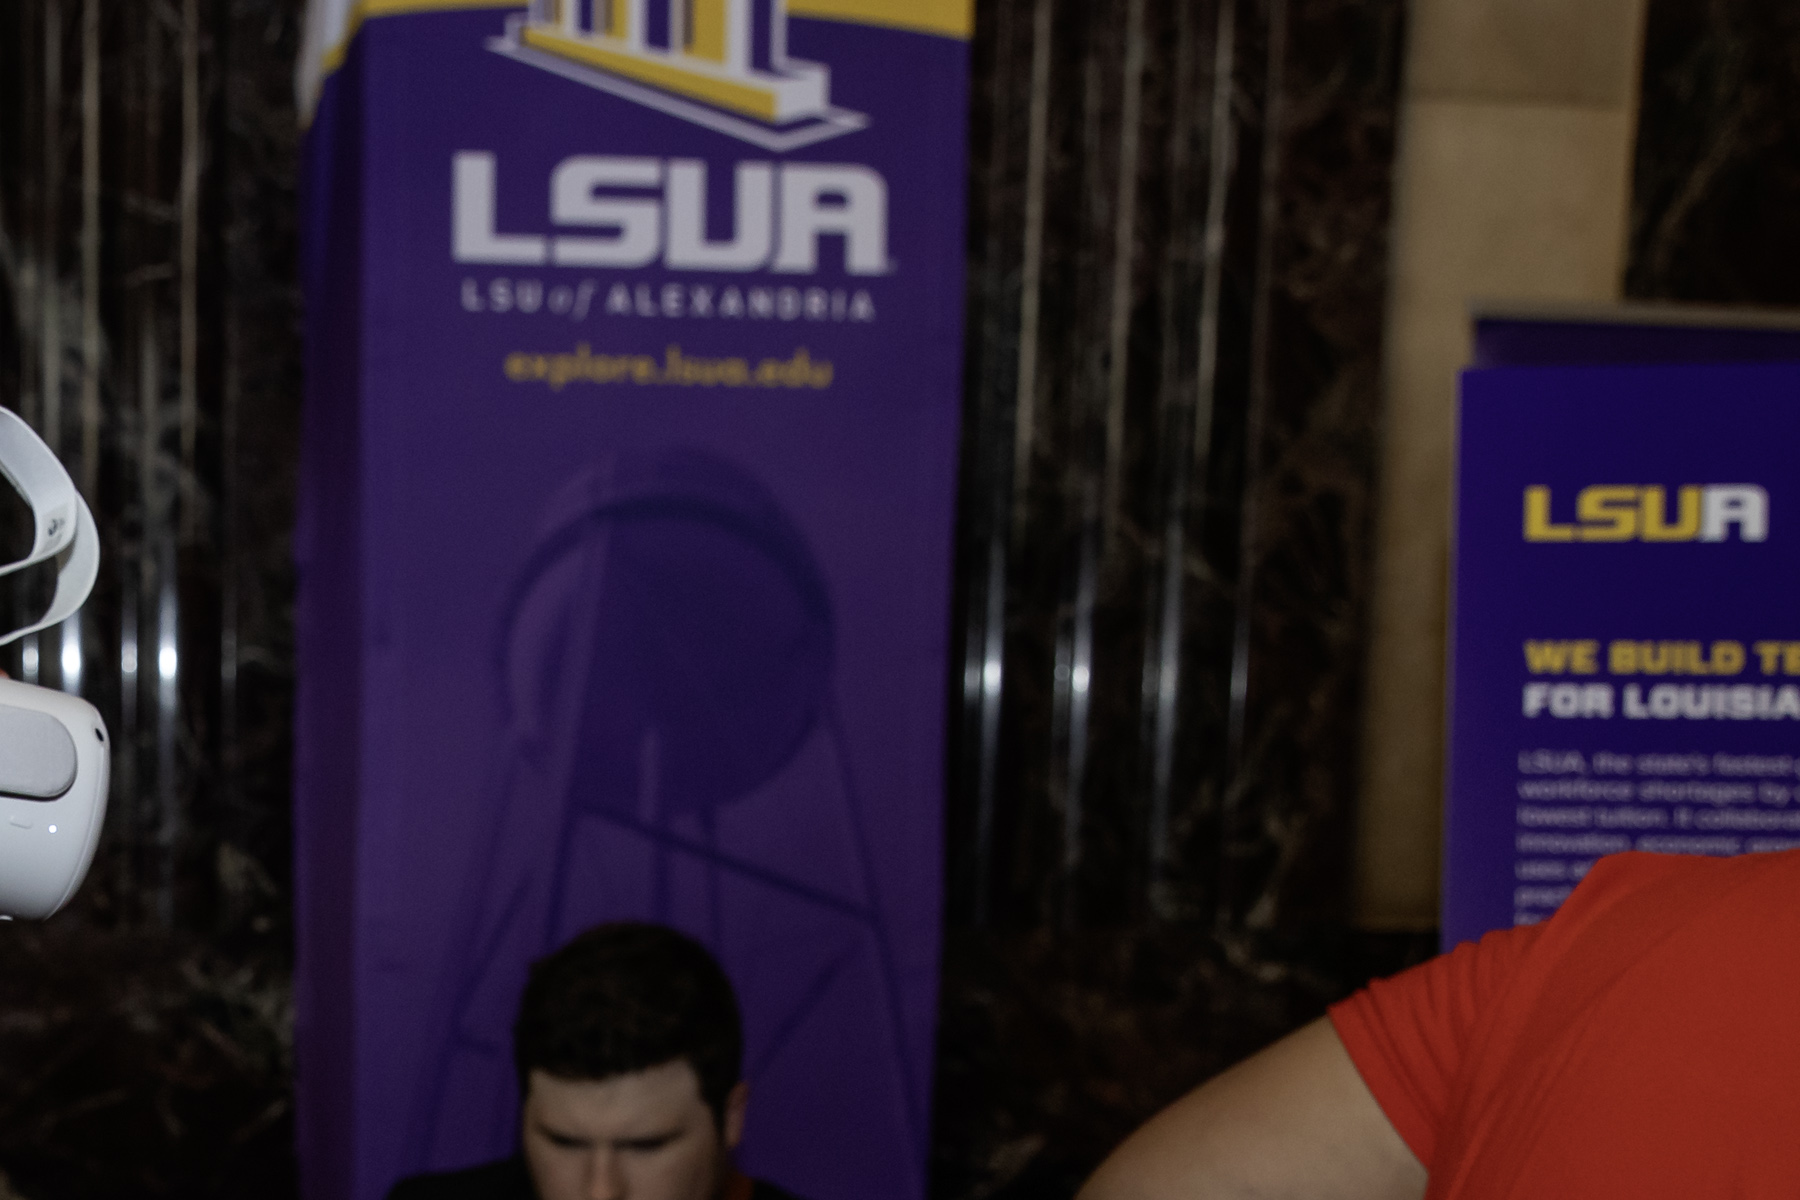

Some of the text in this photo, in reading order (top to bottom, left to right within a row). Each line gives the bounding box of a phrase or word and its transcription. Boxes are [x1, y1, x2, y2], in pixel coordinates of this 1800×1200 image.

[451, 150, 892, 277] LSUA
[461, 277, 876, 323] LSU of ALEXANDRIA
[505, 341, 834, 393] explore.lsua.edu
[1523, 484, 1770, 542] LSUA
[1523, 639, 1600, 675] WE
[1608, 639, 1746, 676] BUILD
[1522, 683, 1615, 719] FOR
